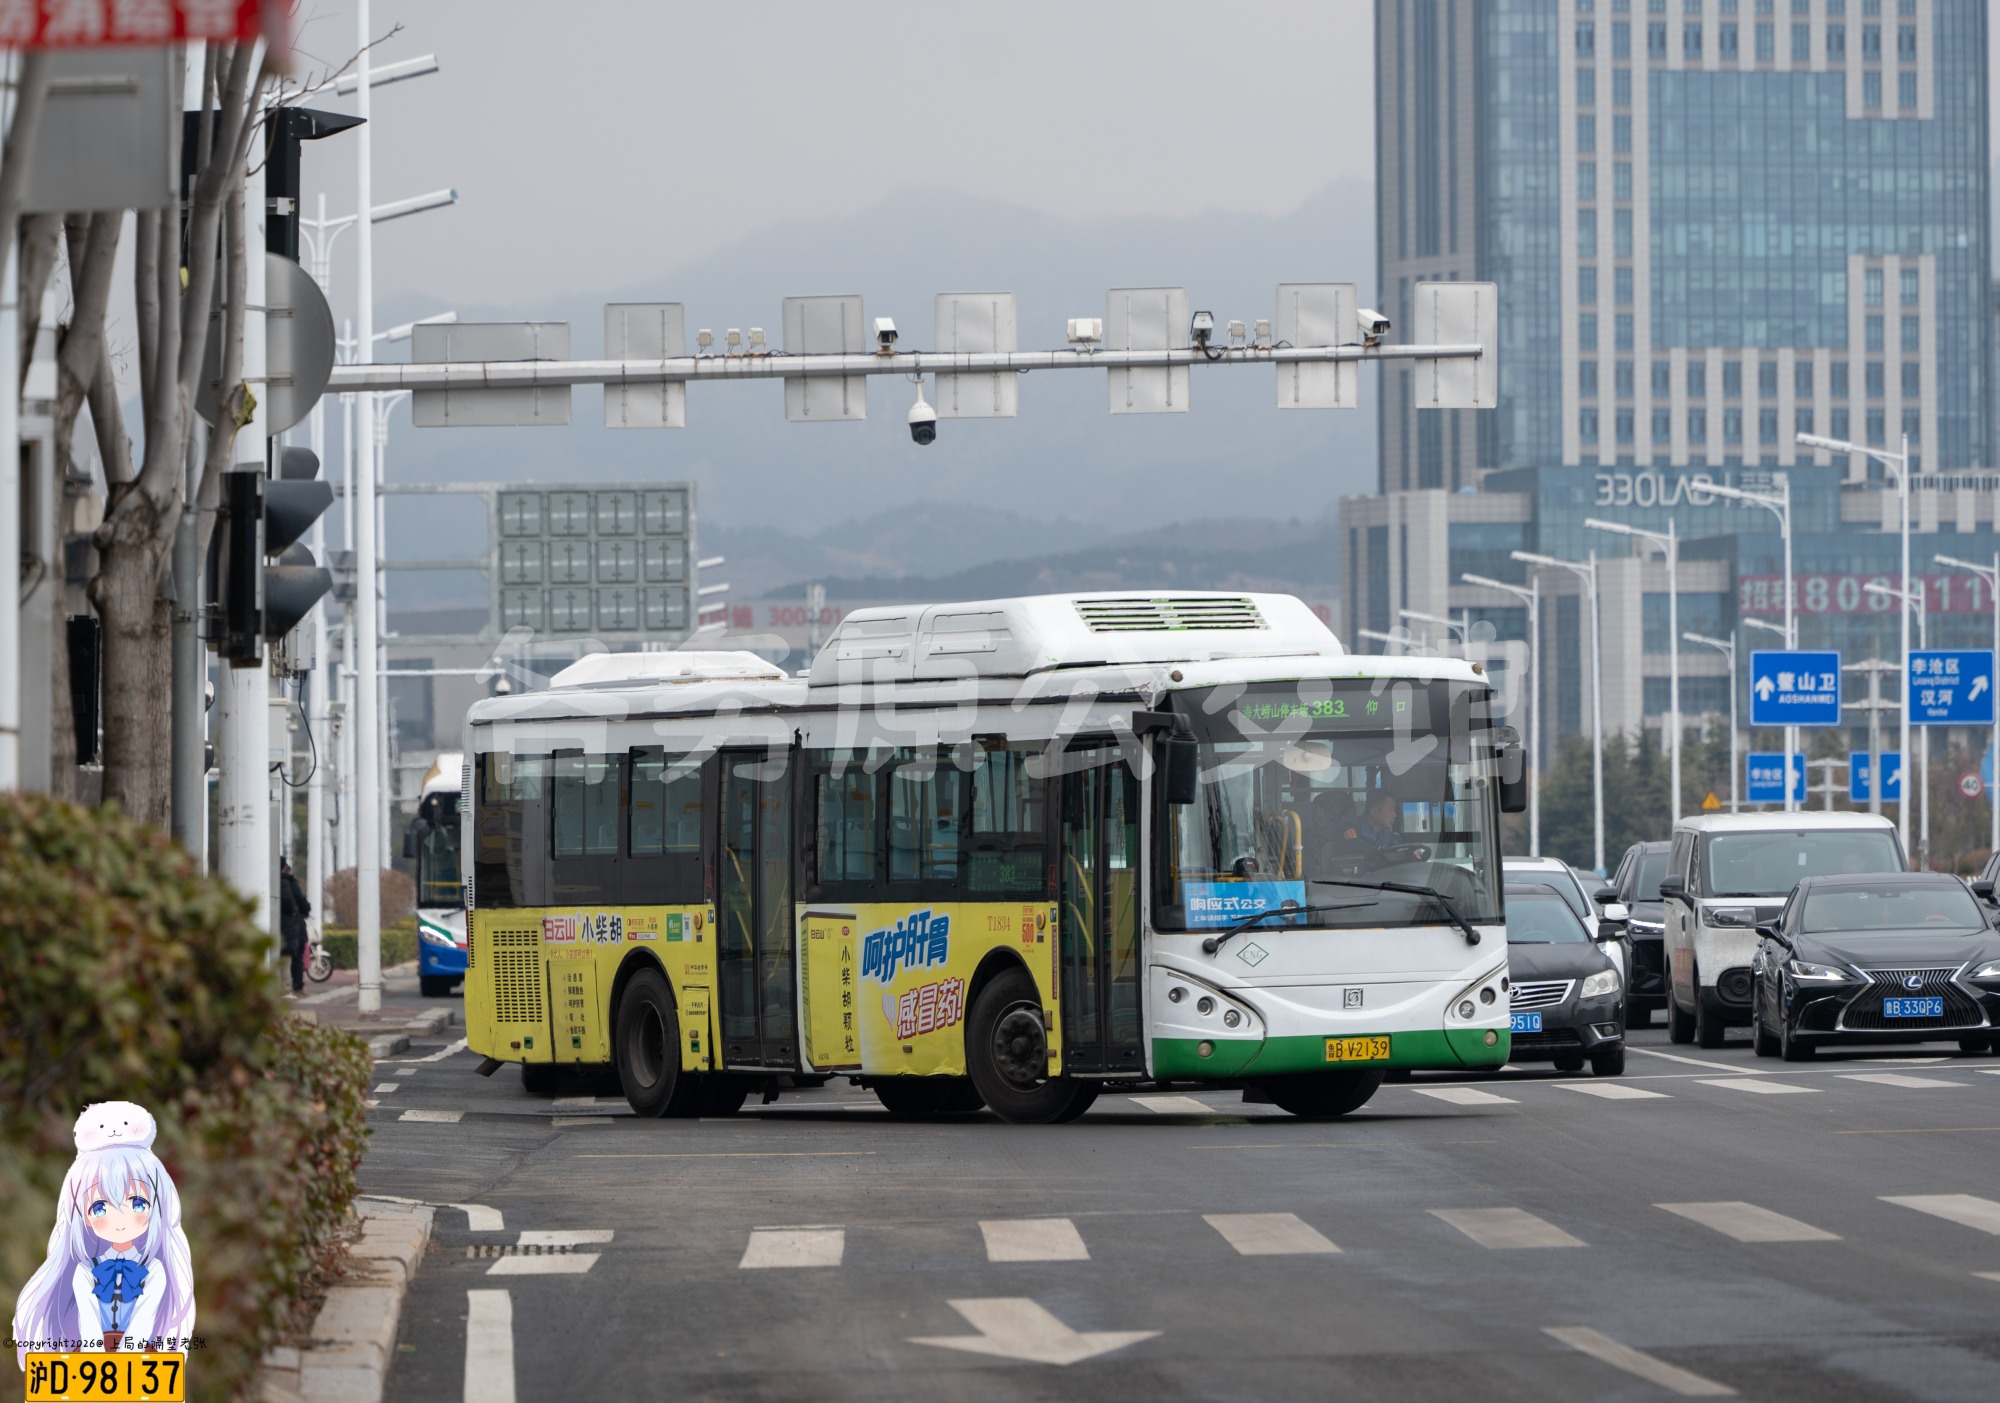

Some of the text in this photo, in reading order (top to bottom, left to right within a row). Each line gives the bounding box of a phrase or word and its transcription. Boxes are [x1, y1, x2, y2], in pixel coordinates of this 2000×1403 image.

[1805, 576, 1982, 611] 80811
[769, 606, 841, 626] 30001
[1312, 700, 1345, 716] 383
[1962, 779, 1978, 792] 40
[999, 864, 1016, 883] 383
[1190, 897, 1267, 911] 响应式公交
[544, 914, 622, 944] 白云山 小柴胡
[987, 915, 1011, 932] T1834
[1022, 923, 1034, 943] 500
[862, 910, 950, 983] 呵护肝胃
[1242, 950, 1263, 959] CNG
[841, 945, 855, 1054] 小柴胡颗粒
[897, 977, 964, 1040] 感冒药!
[1511, 1015, 1540, 1030] 951Q
